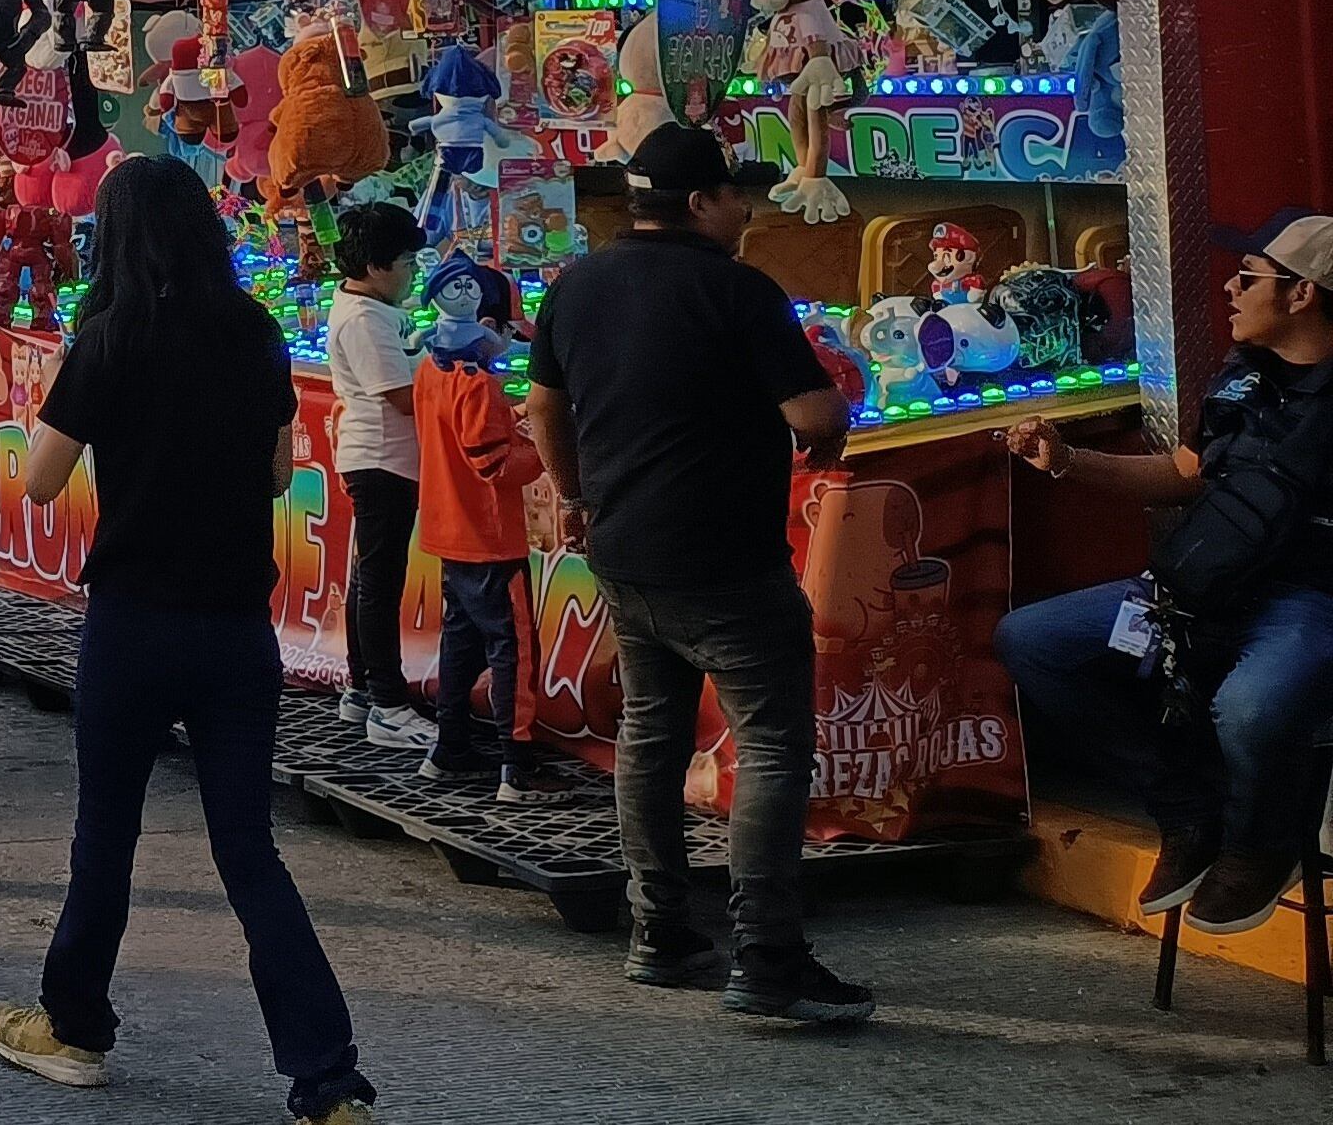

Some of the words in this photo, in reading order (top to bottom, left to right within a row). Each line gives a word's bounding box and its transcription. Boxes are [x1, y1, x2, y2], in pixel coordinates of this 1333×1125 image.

[585, 18, 611, 36] TOP
[849, 111, 963, 176] DE
[913, 719, 1005, 779] ROJAS
